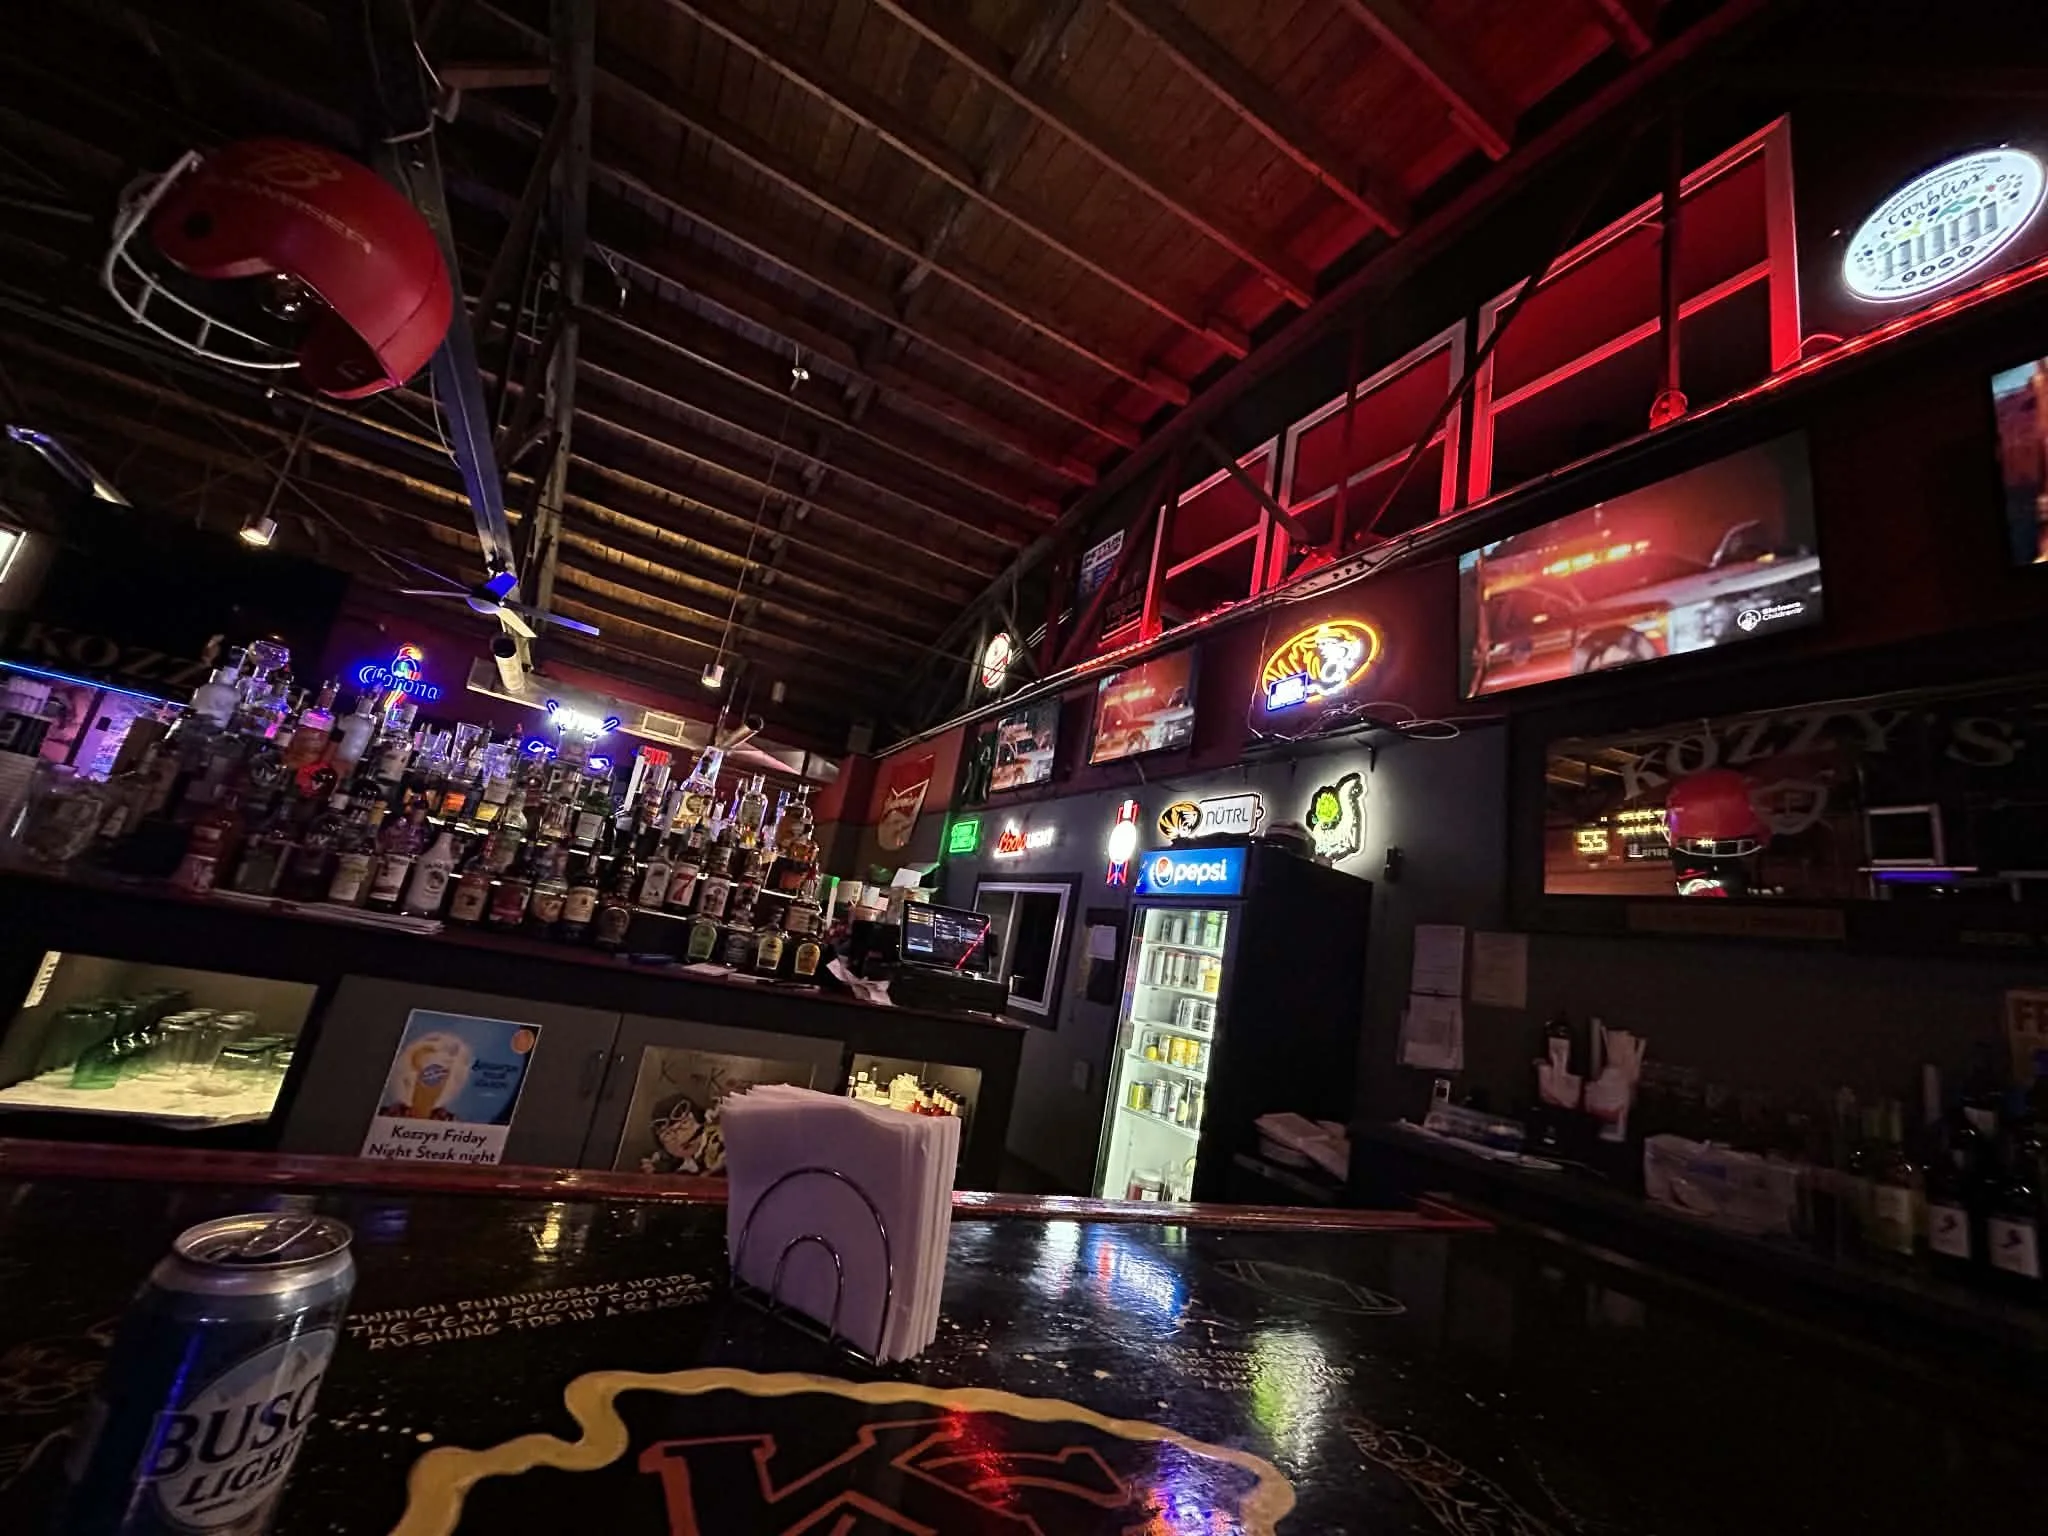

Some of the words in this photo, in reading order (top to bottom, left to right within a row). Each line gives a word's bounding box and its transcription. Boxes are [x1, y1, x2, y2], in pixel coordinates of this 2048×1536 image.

[358, 665, 438, 701] Corona
[1173, 858, 1228, 887] pepsi
[368, 1143, 412, 1159] Night
[415, 1145, 455, 1161] Steak
[391, 1125, 440, 1145] Kozzys
[443, 1128, 488, 1148] Friday
[627, 1273, 696, 1290] HOLDS
[348, 1321, 410, 1338] THE
[418, 1309, 498, 1330] TEAM
[511, 1295, 600, 1318] RECORD
[608, 1289, 650, 1303] FOR
[656, 1280, 713, 1297] MOST
[369, 1323, 501, 1350] RUSHING
[507, 1313, 561, 1330] TDS
[569, 1308, 596, 1321] IN
[606, 1305, 620, 1317] A
[140, 1374, 320, 1478] BUSC
